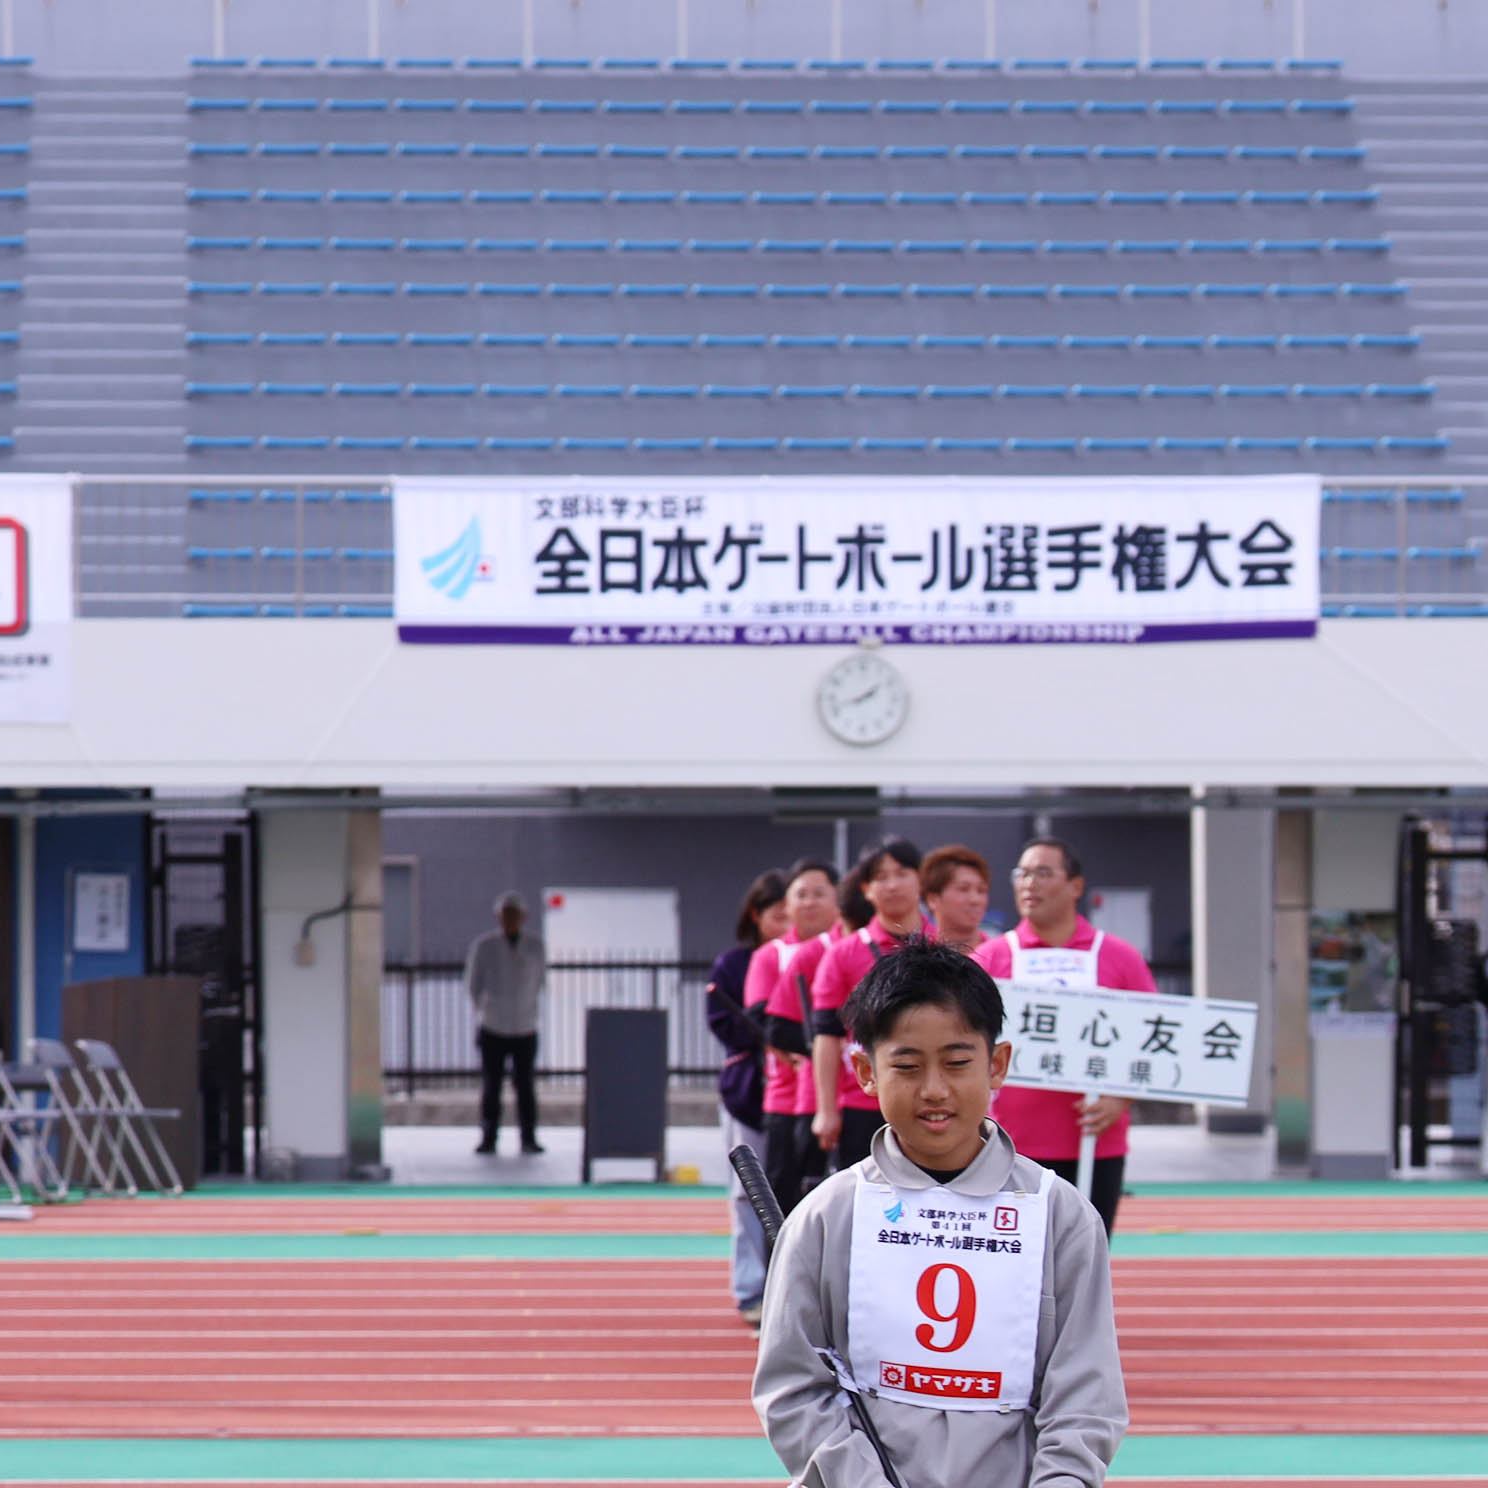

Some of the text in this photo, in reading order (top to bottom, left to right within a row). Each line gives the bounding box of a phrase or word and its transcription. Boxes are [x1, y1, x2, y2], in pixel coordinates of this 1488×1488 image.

[535, 496, 706, 520] 文部科学大臣杯
[535, 520, 1294, 595] 全日本ゲートボール選手権大会
[570, 623, 1147, 644] ALL JAPAN GATEBALL CHAMPIONSHIP
[1018, 1002, 1243, 1062] 垣心友会
[917, 1208, 989, 1223] 文部科学大臣杯
[877, 1228, 1022, 1255] 全日本ゲートボール選手権大会
[915, 1263, 977, 1354] 9
[910, 1371, 997, 1394] ヤマザキ
